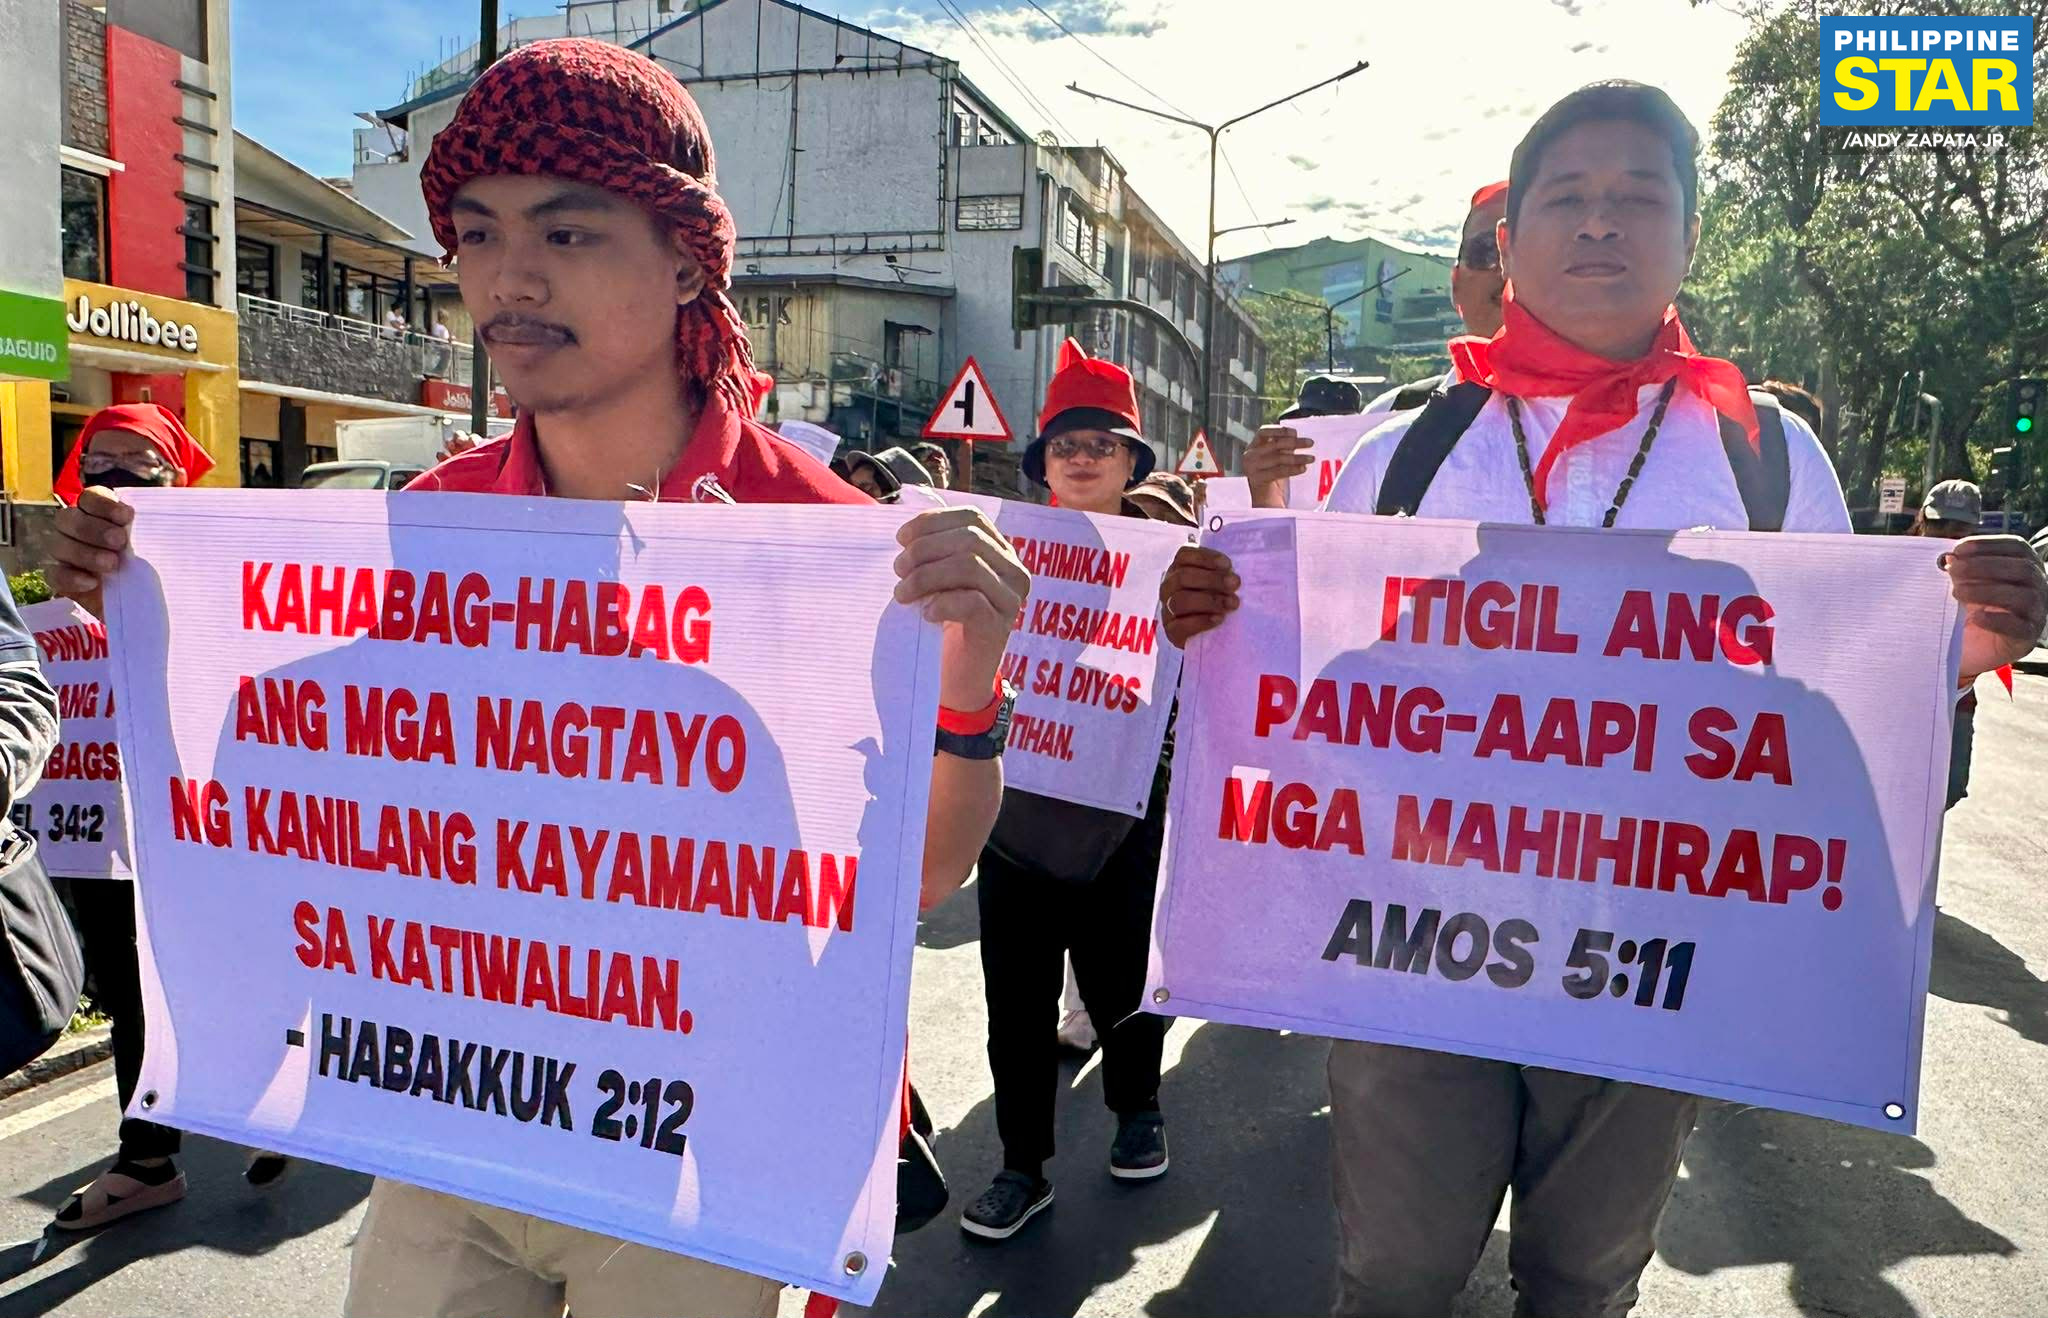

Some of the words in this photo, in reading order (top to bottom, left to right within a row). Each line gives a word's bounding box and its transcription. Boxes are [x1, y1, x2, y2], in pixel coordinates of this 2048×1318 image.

[66, 295, 198, 352] Jollibee
[1003, 535, 1131, 590] TAHIMIKAN
[242, 560, 713, 665] KAHABAG-HABAG
[1029, 599, 1157, 656] KASAMAAN
[1380, 576, 1578, 653] ITIGIL
[1603, 591, 1777, 667] ANG
[54, 682, 98, 719] ANG
[236, 675, 328, 752] ANG
[345, 685, 456, 765] MGA
[476, 697, 746, 793] NAGTAYO
[1032, 658, 1063, 698] SA
[1066, 665, 1142, 714] DIYOS
[1255, 675, 1657, 771] PANG-AAPI
[1684, 708, 1793, 786] SA
[42, 741, 121, 783] BAGS
[48, 803, 105, 842] 34:2
[170, 777, 232, 848] NG
[246, 786, 478, 885] KANILANG
[497, 820, 859, 933] KAYAMANAN
[1218, 777, 1366, 856] MGA
[1392, 796, 1846, 910] MAHIHIRAP!
[294, 902, 355, 975] SA
[368, 917, 694, 1035] KATIWALIAN.
[1322, 899, 1540, 988] AMOS
[1562, 928, 1696, 1012] 5:11
[319, 1014, 577, 1132] HABAKKUK
[592, 1070, 694, 1157] 2:12
